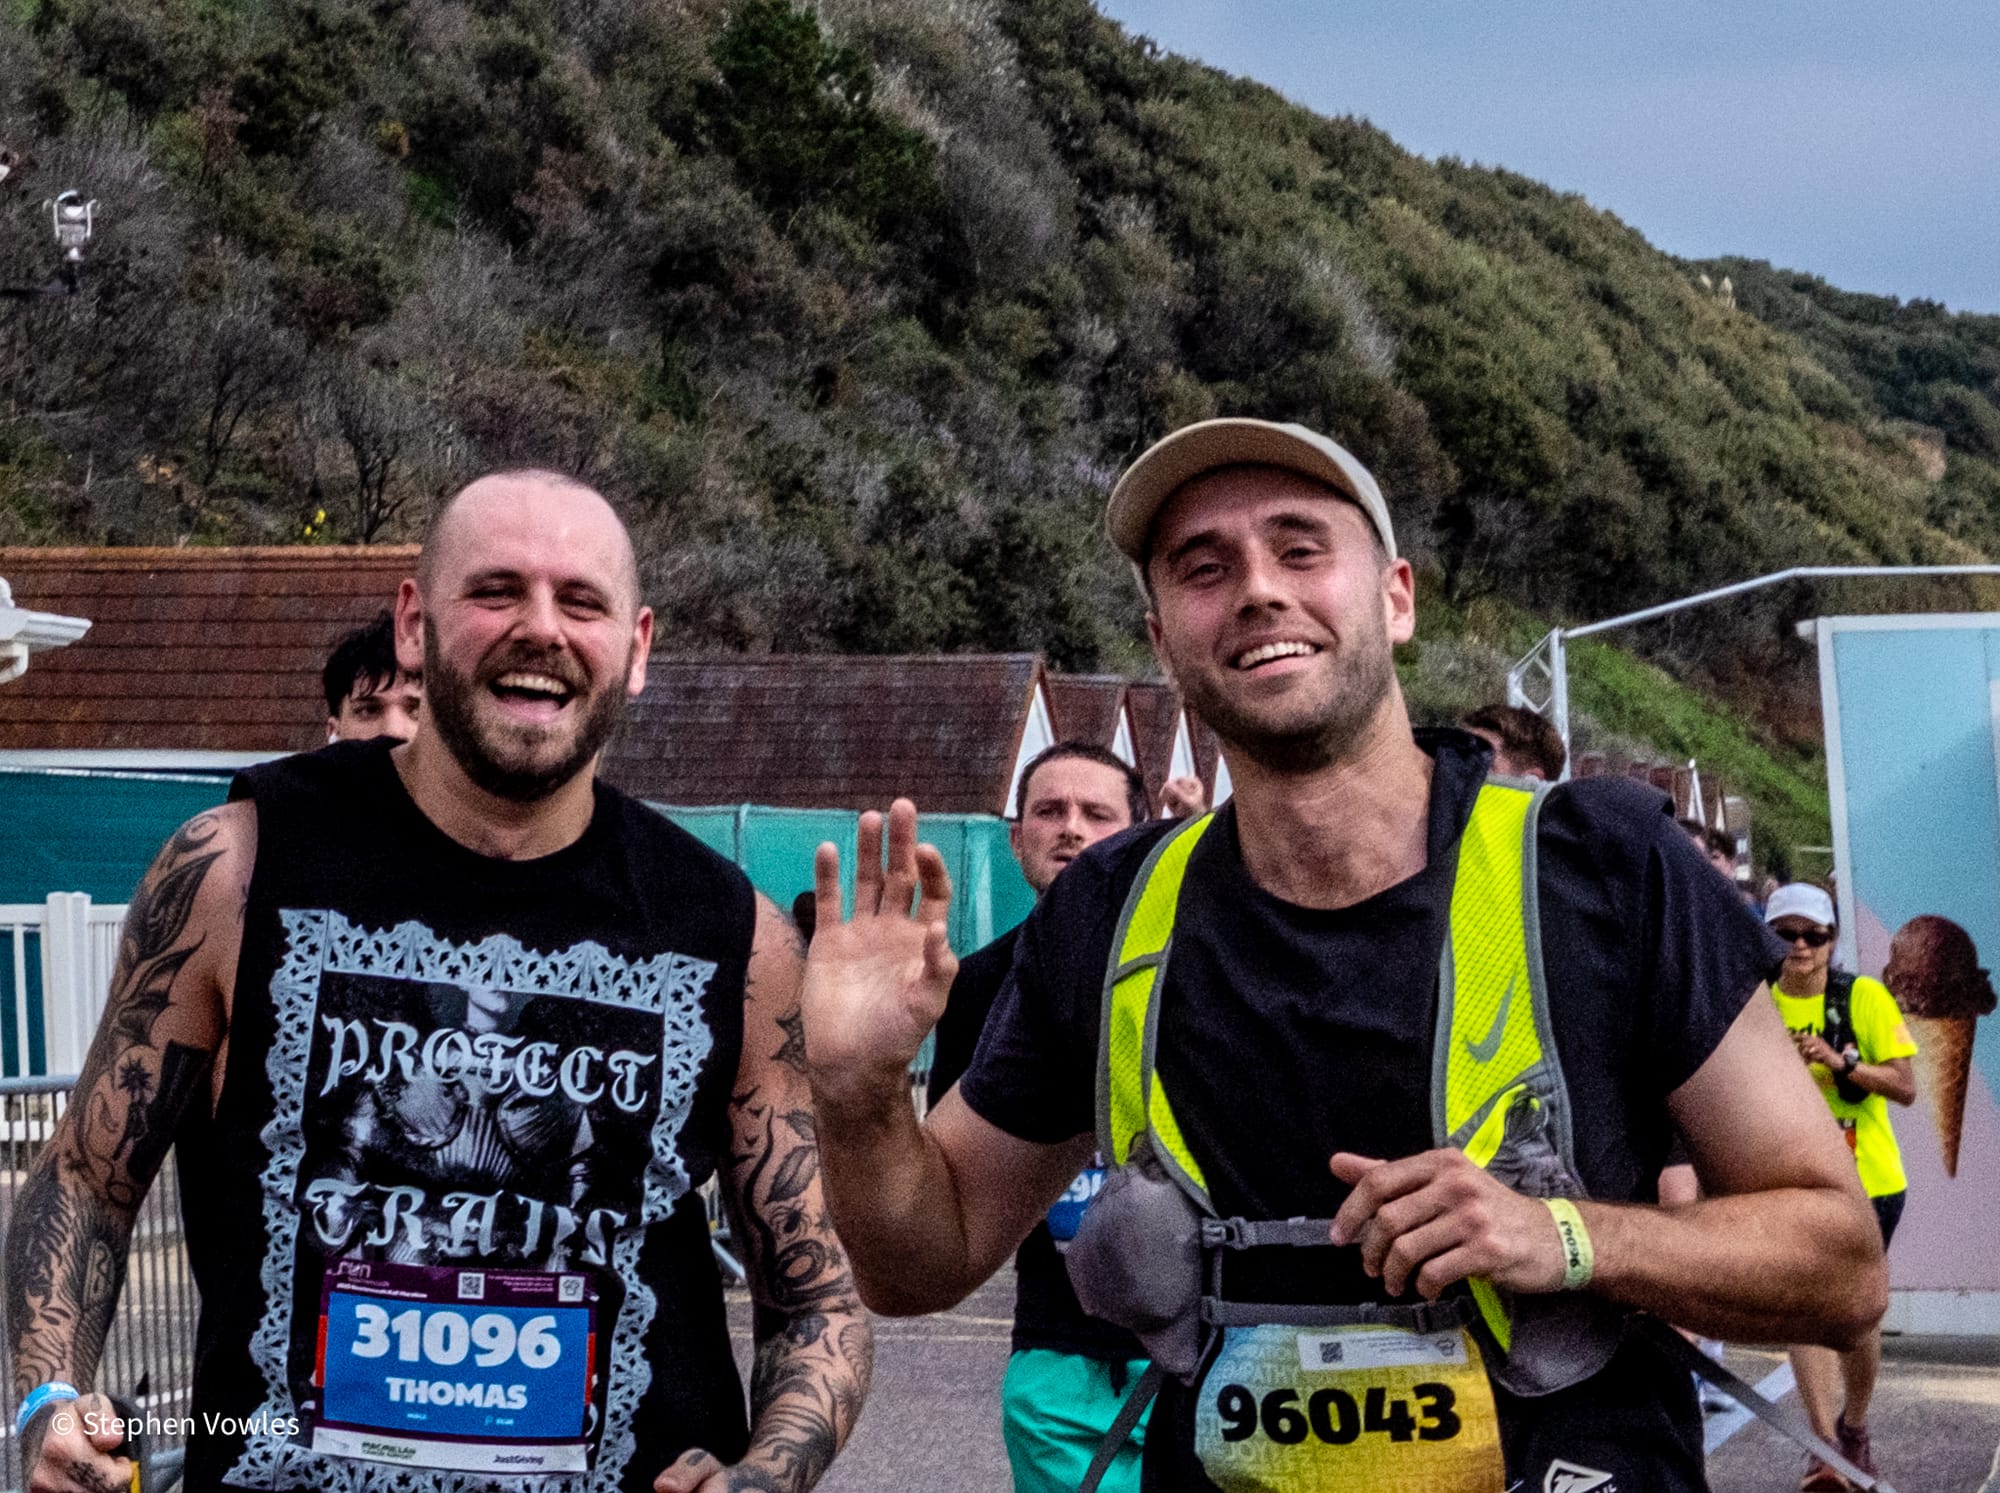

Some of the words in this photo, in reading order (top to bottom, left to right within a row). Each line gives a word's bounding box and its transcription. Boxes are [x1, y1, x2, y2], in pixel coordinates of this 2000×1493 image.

[319, 1013, 657, 1113] PROTECT
[351, 1303, 562, 1370] 31096
[385, 1376, 529, 1410] THOMAS
[1216, 1382, 1462, 1445] 96043
